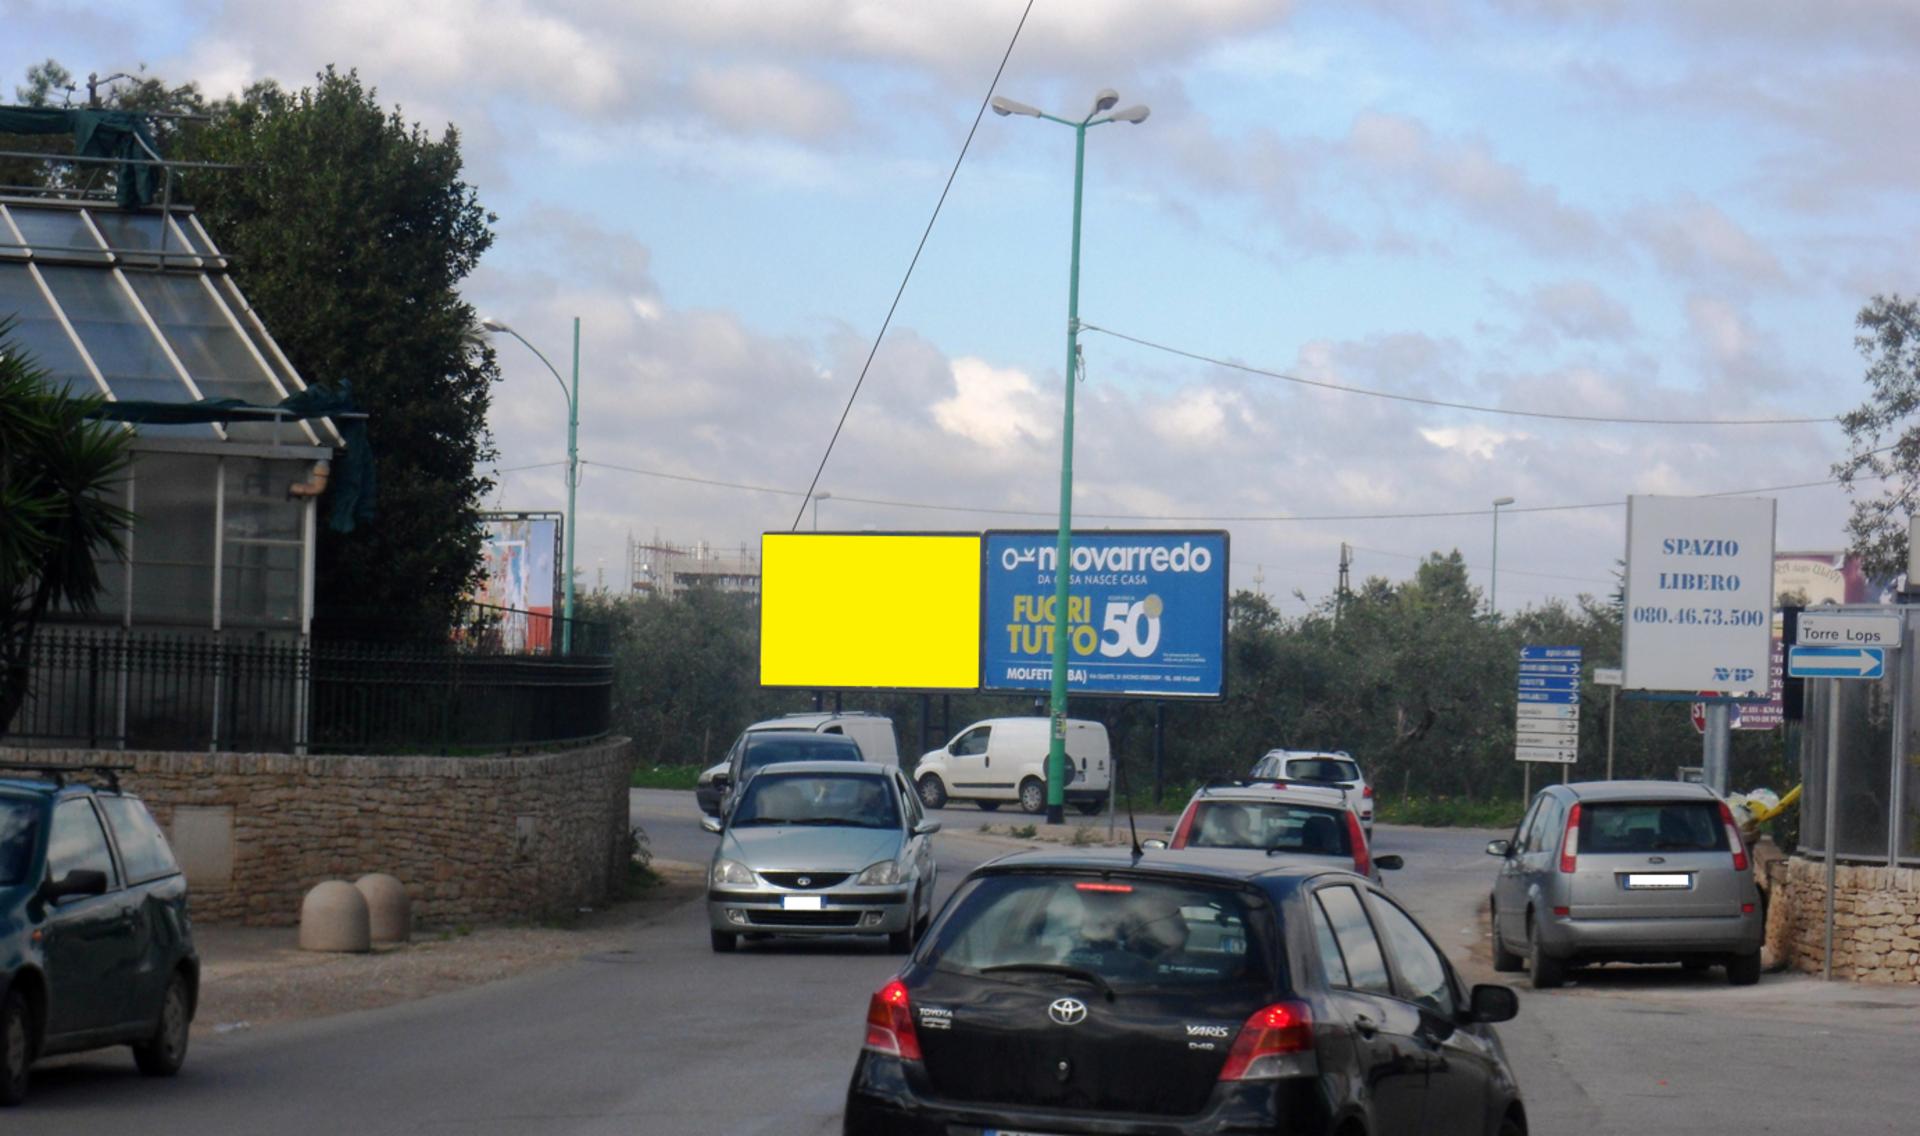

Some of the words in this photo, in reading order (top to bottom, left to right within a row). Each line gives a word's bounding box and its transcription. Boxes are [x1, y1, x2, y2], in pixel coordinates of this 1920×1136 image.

[1662, 538, 1739, 557] SPAZIO
[1038, 543, 1211, 572] novarredo
[1038, 575, 1050, 585] DA
[1054, 575, 1081, 585] SA
[1085, 575, 1117, 585] NASCE
[1121, 576, 1147, 585] CASA
[1659, 573, 1740, 591] LIBERO
[1633, 606, 1764, 627] 080.46.73.500
[1803, 627, 1839, 640] Torre
[1846, 629, 1881, 643] Lops
[1006, 667, 1055, 681] MOLFETT
[1067, 669, 1088, 684] BA)
[919, 1007, 953, 1018] TOYOTA
